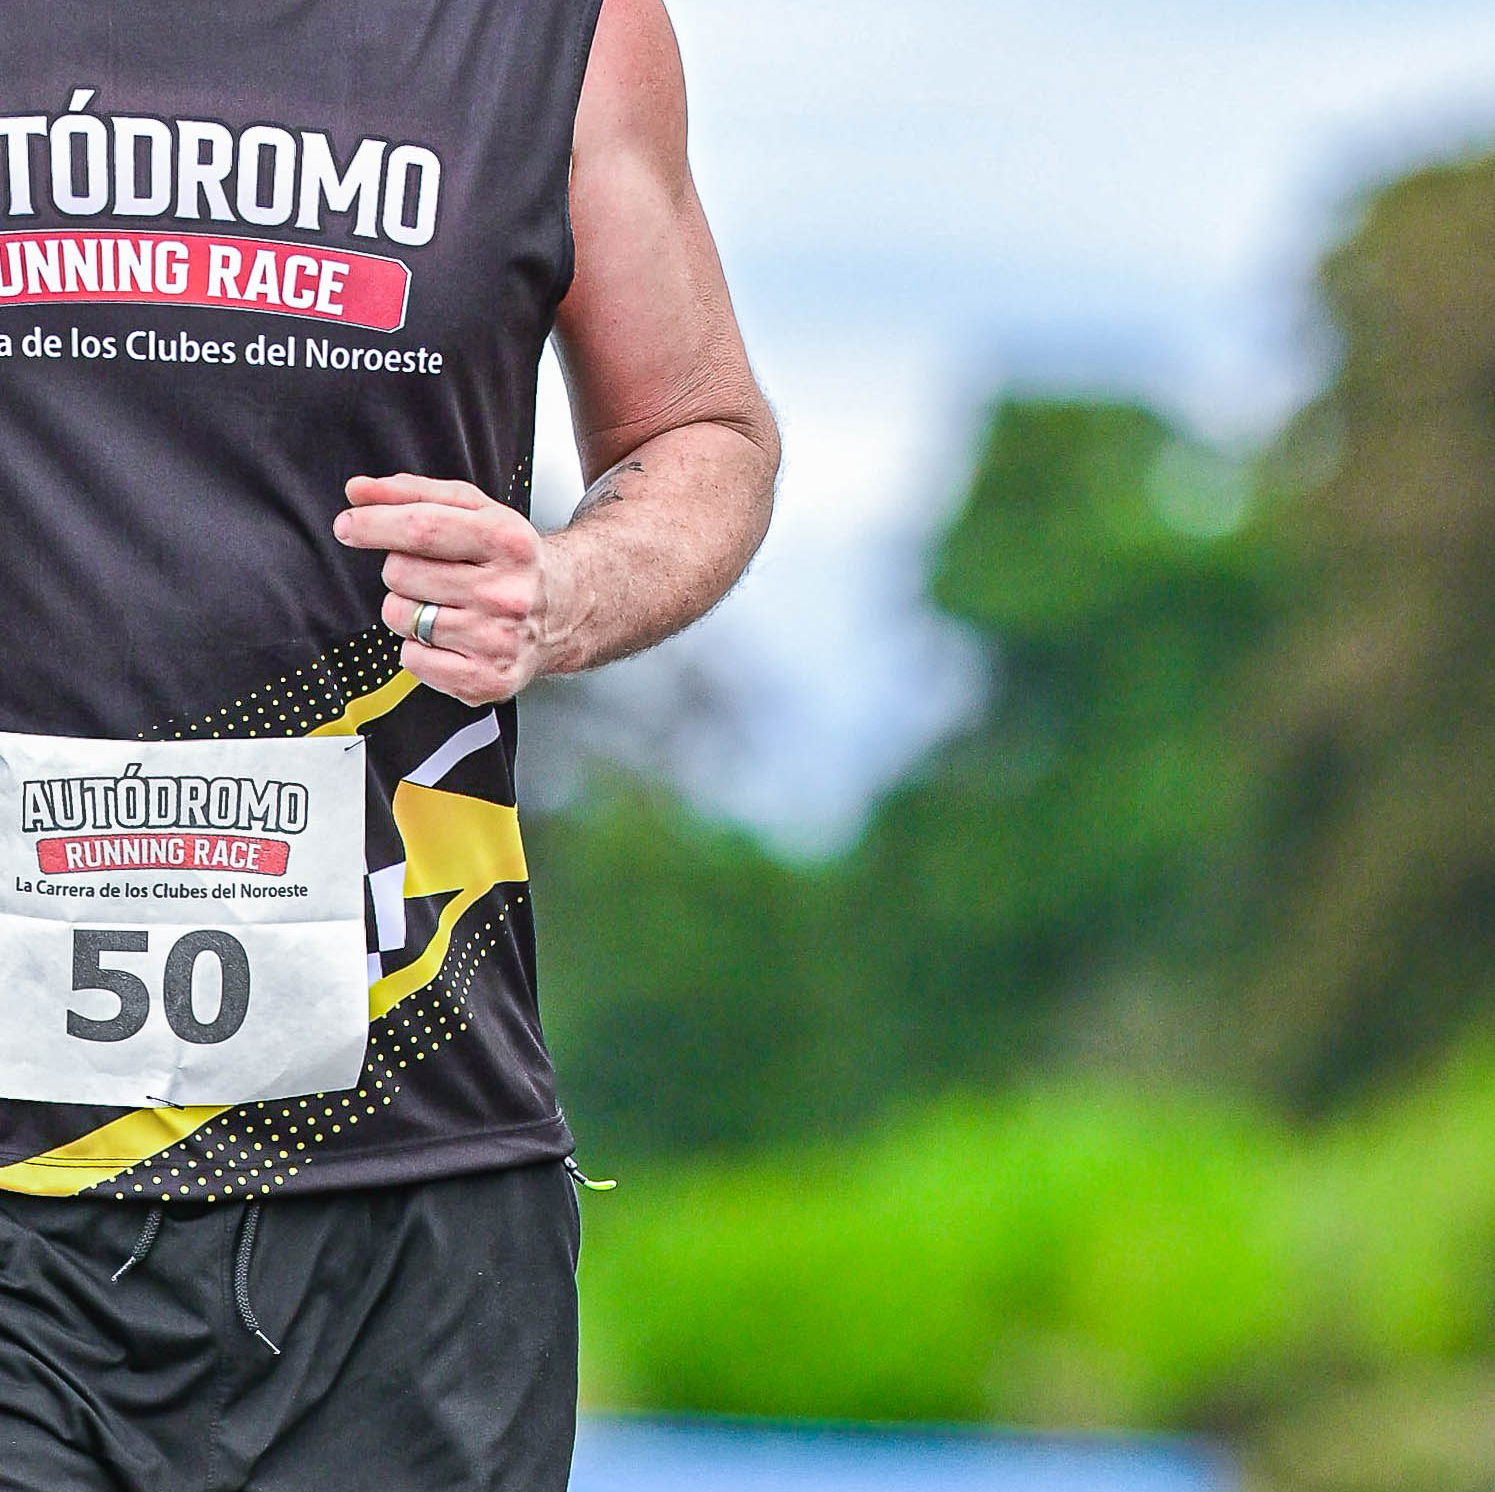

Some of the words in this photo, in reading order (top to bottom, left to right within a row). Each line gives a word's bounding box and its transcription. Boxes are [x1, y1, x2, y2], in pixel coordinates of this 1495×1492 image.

[206, 243, 351, 316] RACE
[20, 327, 64, 359] de
[71, 327, 117, 360] los
[124, 330, 237, 365] Clubes
[243, 334, 296, 368] del
[305, 341, 444, 375] Noroeste
[21, 763, 309, 835] AUTÓDROMO
[63, 839, 185, 871] RUNNING
[193, 838, 262, 871] RACE
[15, 876, 33, 894] La
[36, 879, 96, 898] Carrera
[99, 882, 121, 899] de
[124, 882, 149, 899] los
[152, 883, 208, 900] Clubes
[211, 882, 237, 900] del
[240, 882, 309, 898] Noroeste
[66, 928, 251, 1045] 50
